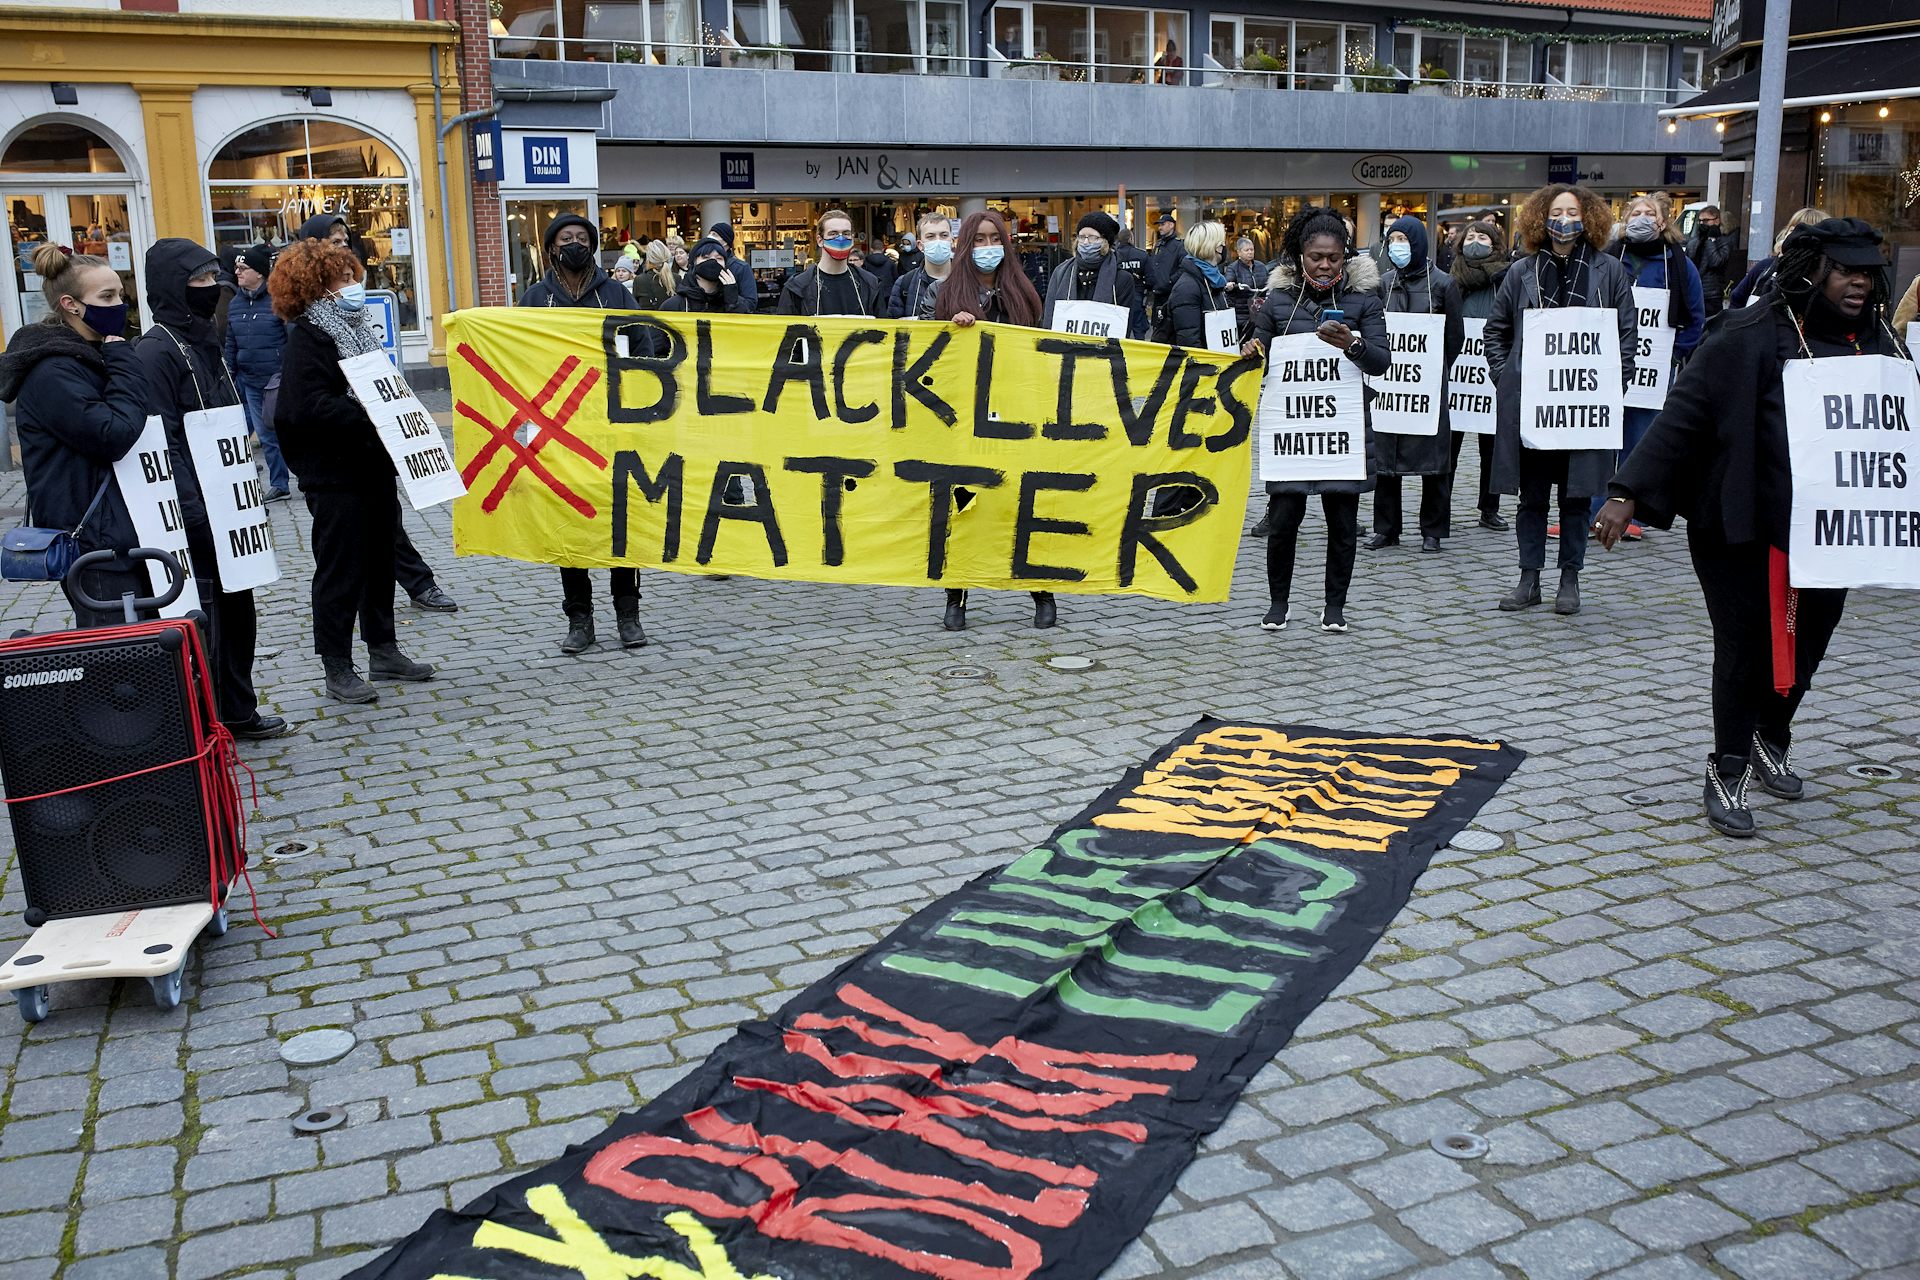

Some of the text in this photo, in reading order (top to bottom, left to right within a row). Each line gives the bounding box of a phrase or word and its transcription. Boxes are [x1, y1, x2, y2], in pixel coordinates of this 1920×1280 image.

[476, 133, 492, 157] DIN
[531, 146, 560, 165] DIN
[726, 160, 748, 174] DIN
[806, 154, 960, 190] by JAN & NALLE
[1360, 161, 1407, 178] Garagen
[1550, 164, 1572, 172] ZEISS
[1637, 308, 1661, 328] CK
[1545, 332, 1601, 355] BLACK
[1282, 358, 1341, 382] BLACK
[1384, 363, 1421, 383] LIVES
[1548, 369, 1598, 392] LIVES
[602, 313, 1264, 452] BLACK LIVES
[1285, 395, 1337, 419] LIVES
[1375, 391, 1430, 413] MATTER
[1823, 394, 1910, 431] BLACK
[396, 411, 430, 439] LIVES
[1535, 405, 1610, 428] MATTER
[1274, 432, 1350, 456] MATTER
[404, 448, 451, 480] MATTER
[1835, 451, 1907, 489] LIVES
[611, 449, 1220, 596] MATTER
[1815, 509, 1920, 547] MATTER
[3, 667, 85, 689] SOUNDBOKS
